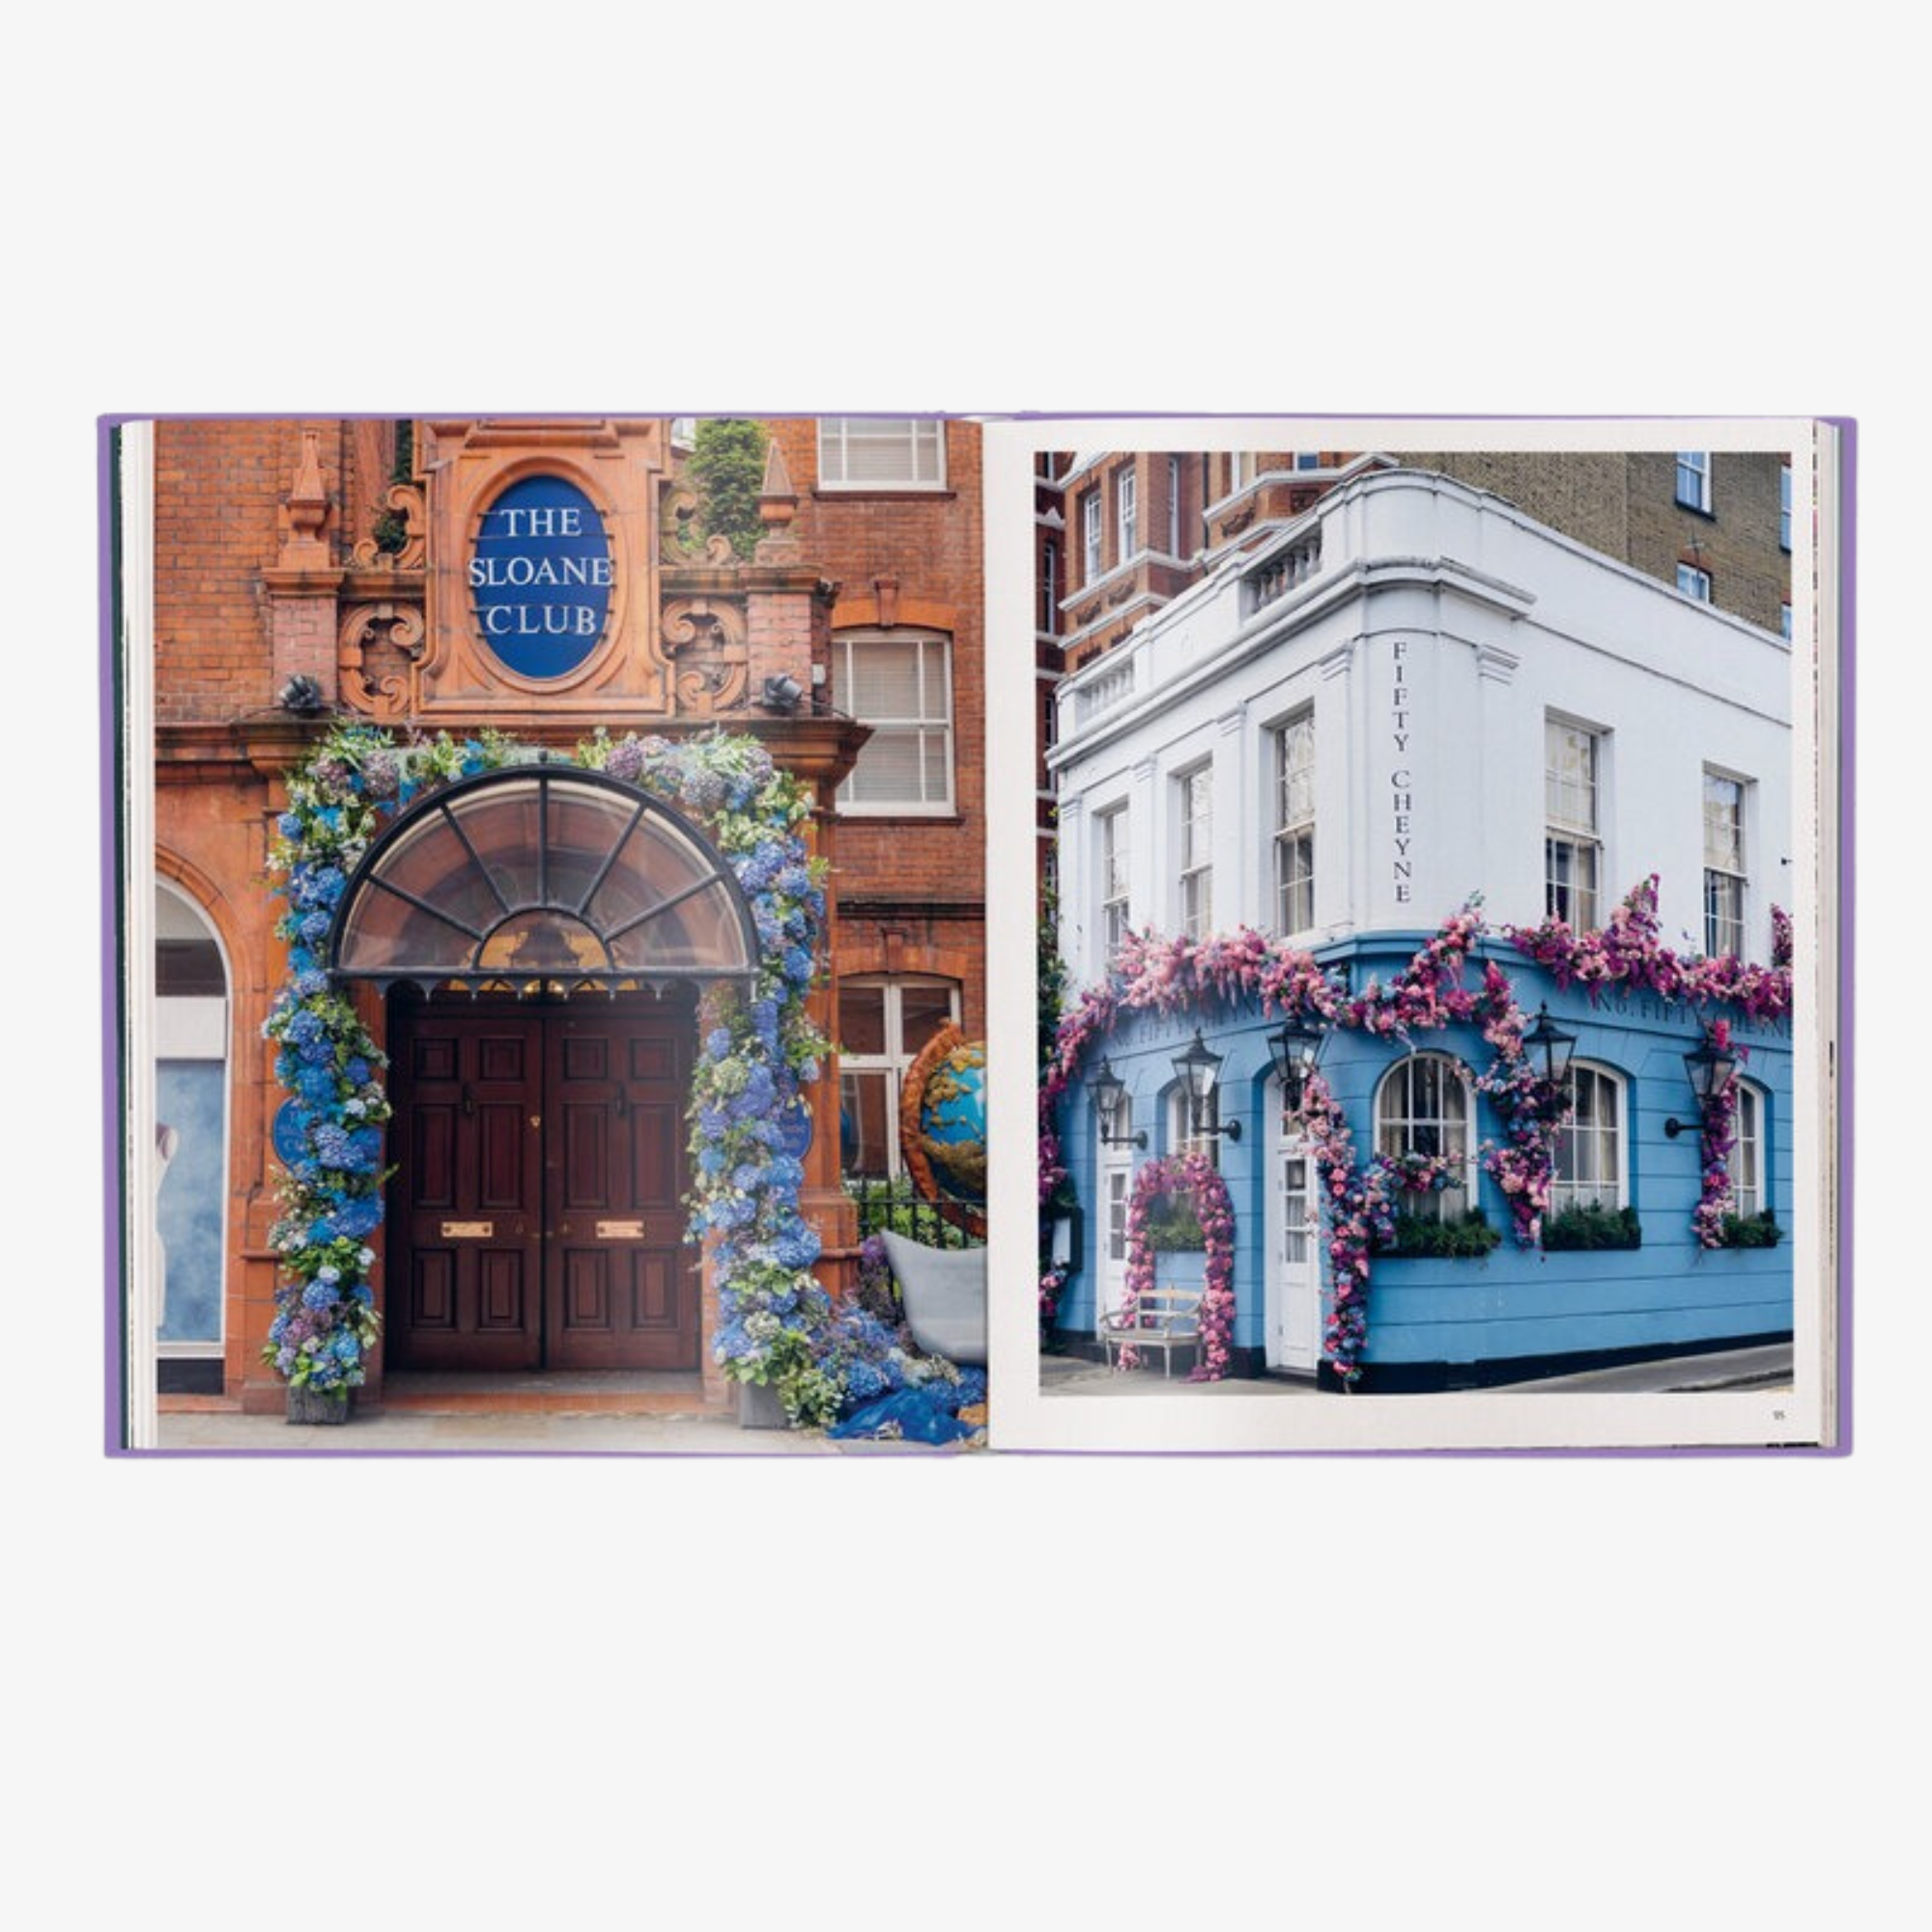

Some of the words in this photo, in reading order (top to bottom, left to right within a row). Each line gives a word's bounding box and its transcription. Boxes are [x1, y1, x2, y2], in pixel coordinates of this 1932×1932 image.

[500, 509, 582, 537] THE
[469, 557, 614, 587] SLOANE
[487, 606, 597, 636] CLUB
[1392, 641, 1409, 752] FIFTY
[1391, 770, 1411, 903] CHEYNE
